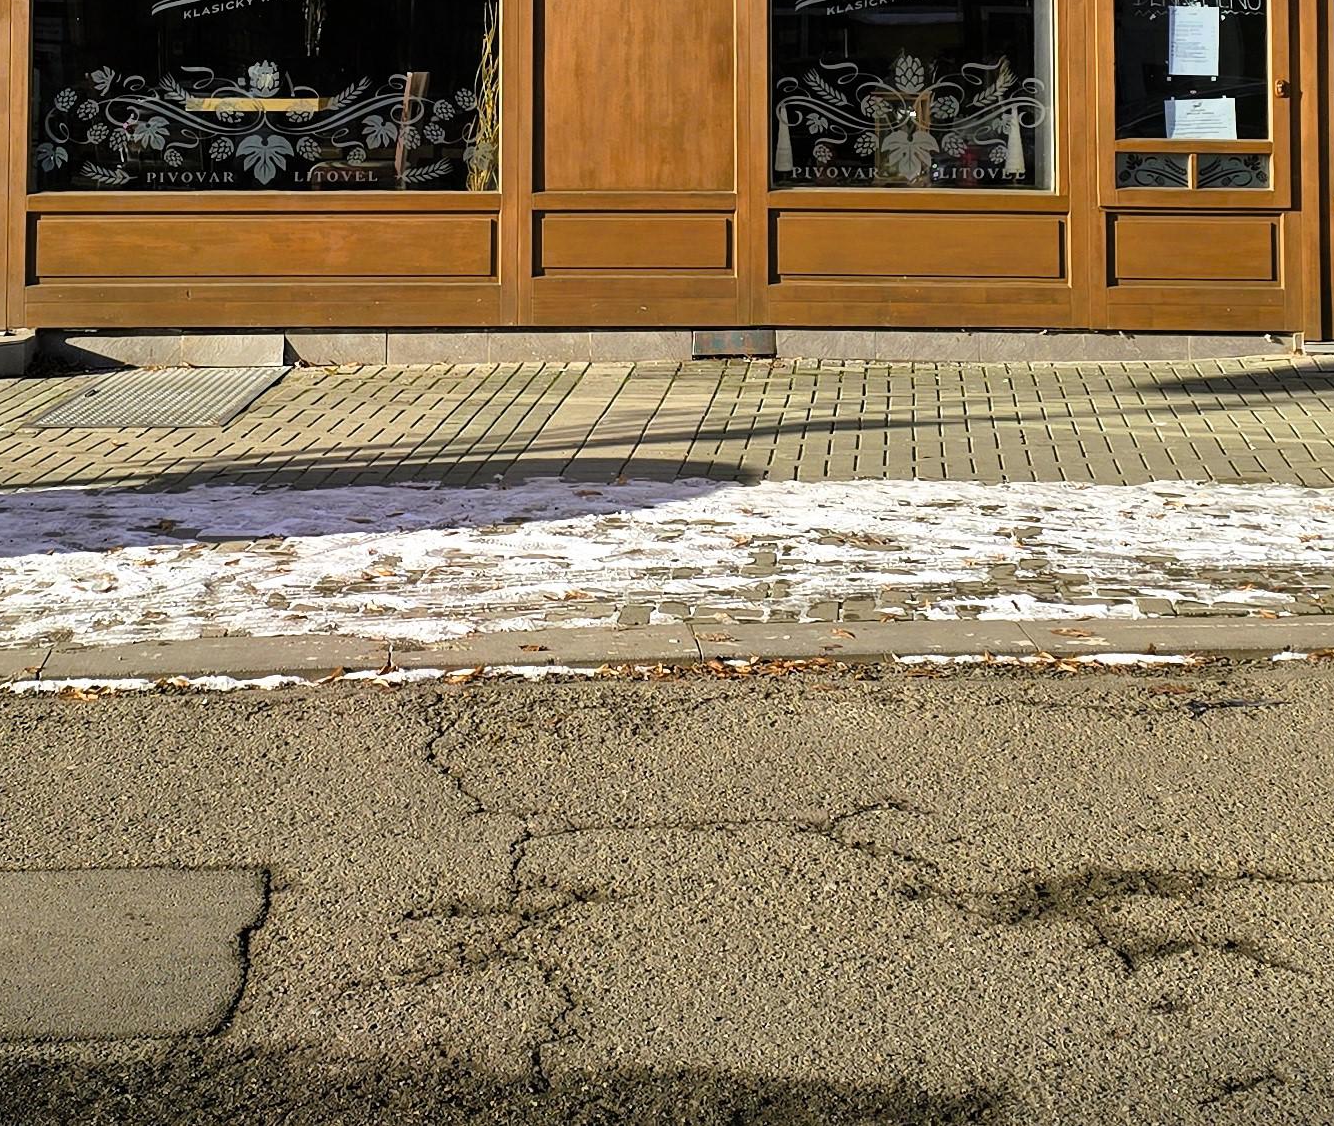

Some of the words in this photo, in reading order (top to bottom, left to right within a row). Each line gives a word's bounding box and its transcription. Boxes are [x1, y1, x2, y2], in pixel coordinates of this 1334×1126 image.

[146, 171, 234, 183] PIVOVAR
[294, 171, 378, 182] LITOVEL
[792, 167, 878, 179] PIVOVAR
